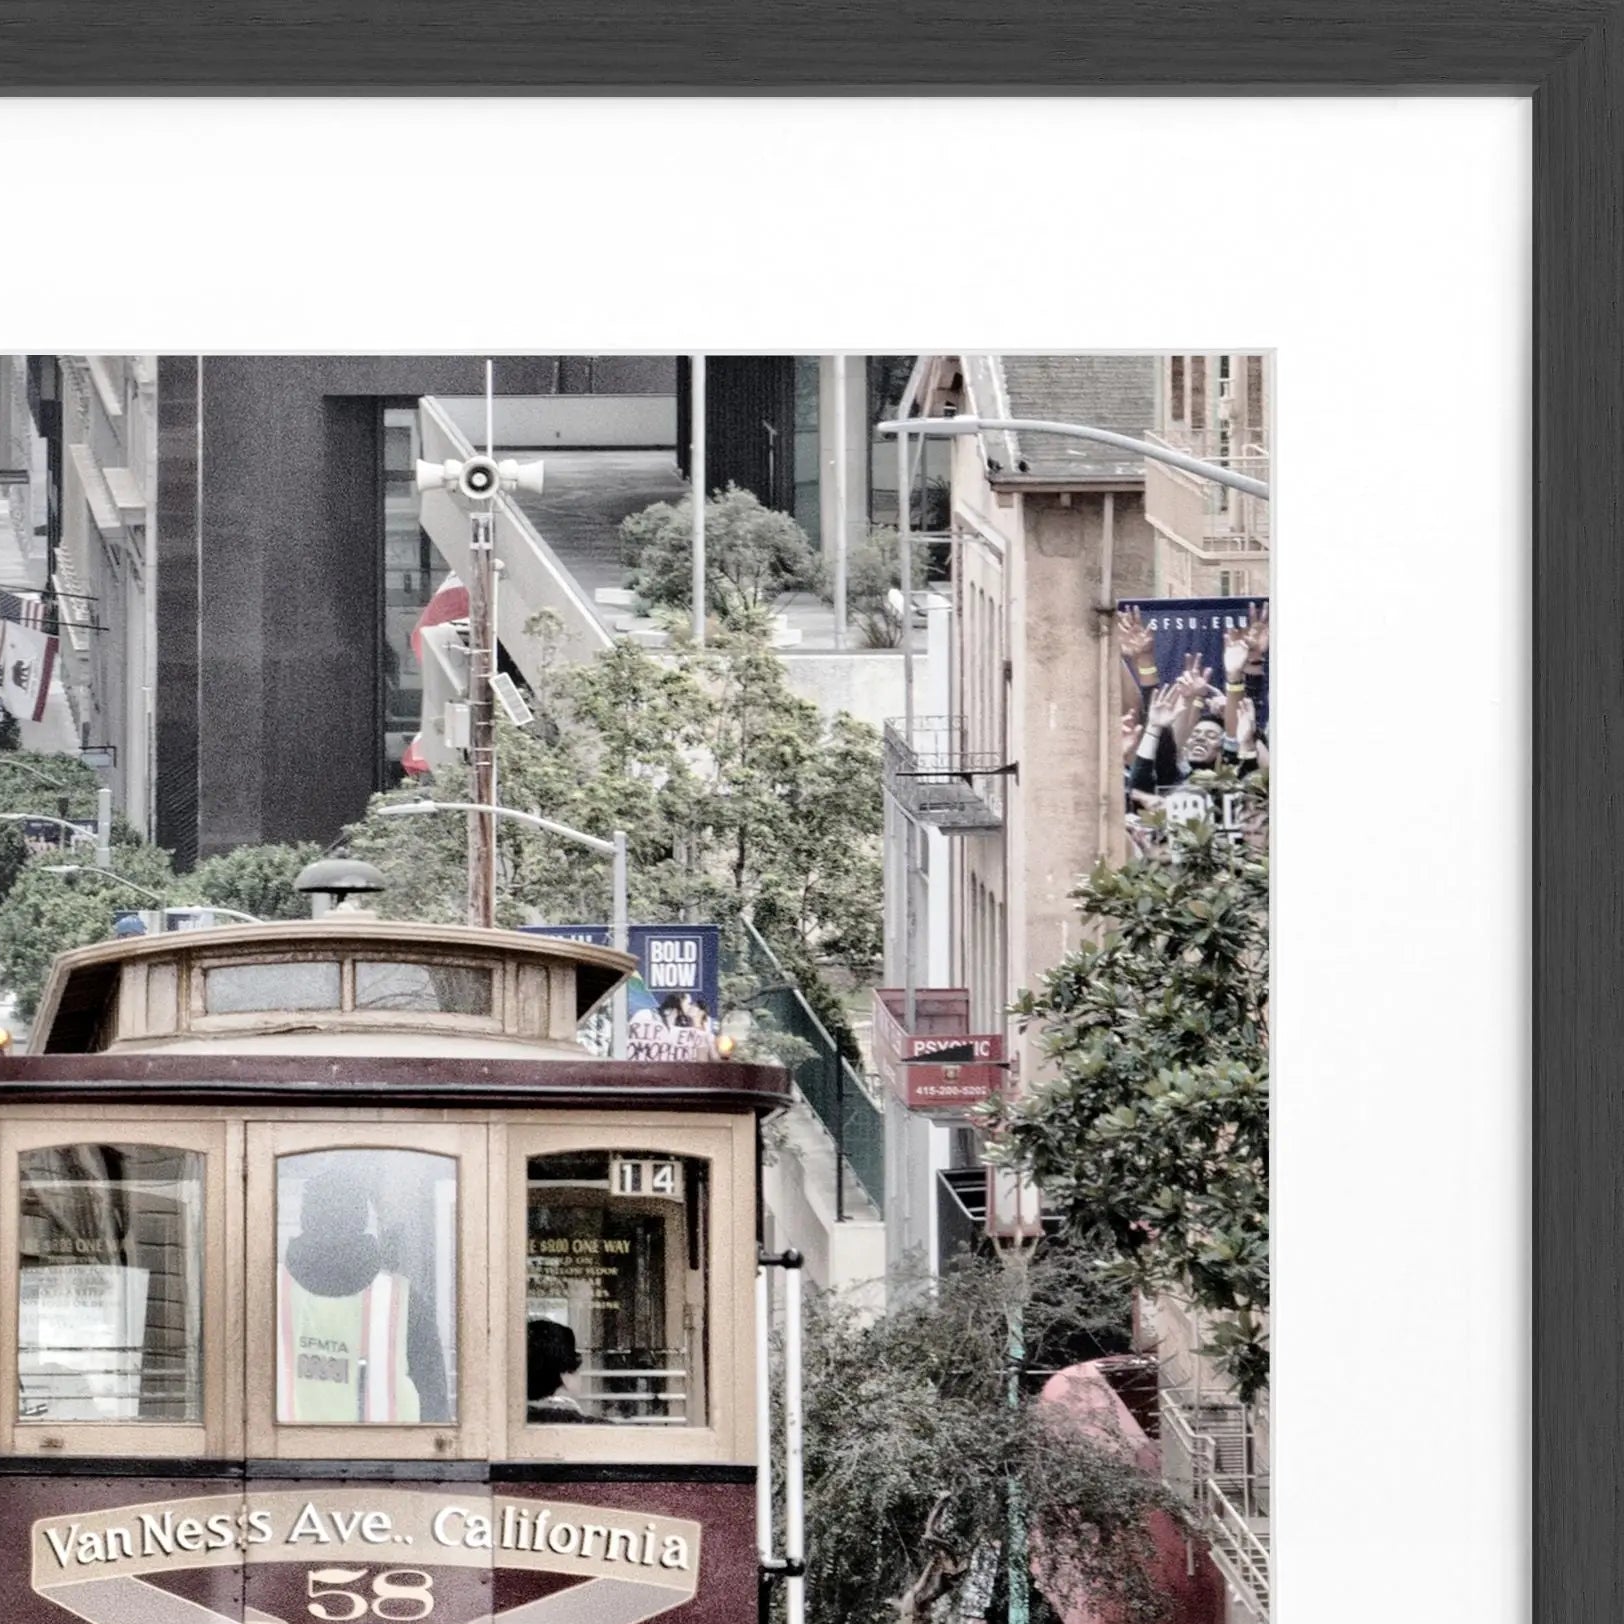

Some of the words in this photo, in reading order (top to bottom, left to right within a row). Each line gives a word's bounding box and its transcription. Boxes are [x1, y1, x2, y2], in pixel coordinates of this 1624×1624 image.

[1150, 616, 1248, 631] SFSU.EDU
[651, 940, 696, 963] BOLD
[651, 963, 696, 987] NOW
[914, 1040, 990, 1057] PSYCIC
[620, 1163, 675, 1194] 14
[572, 1238, 599, 1254] ONE
[603, 1239, 631, 1254] WAY
[299, 1335, 350, 1354] SFMTA
[44, 1522, 133, 1568] Van
[138, 1509, 273, 1557] Ness
[432, 1505, 690, 1571] California
[307, 1569, 435, 1622] 58
